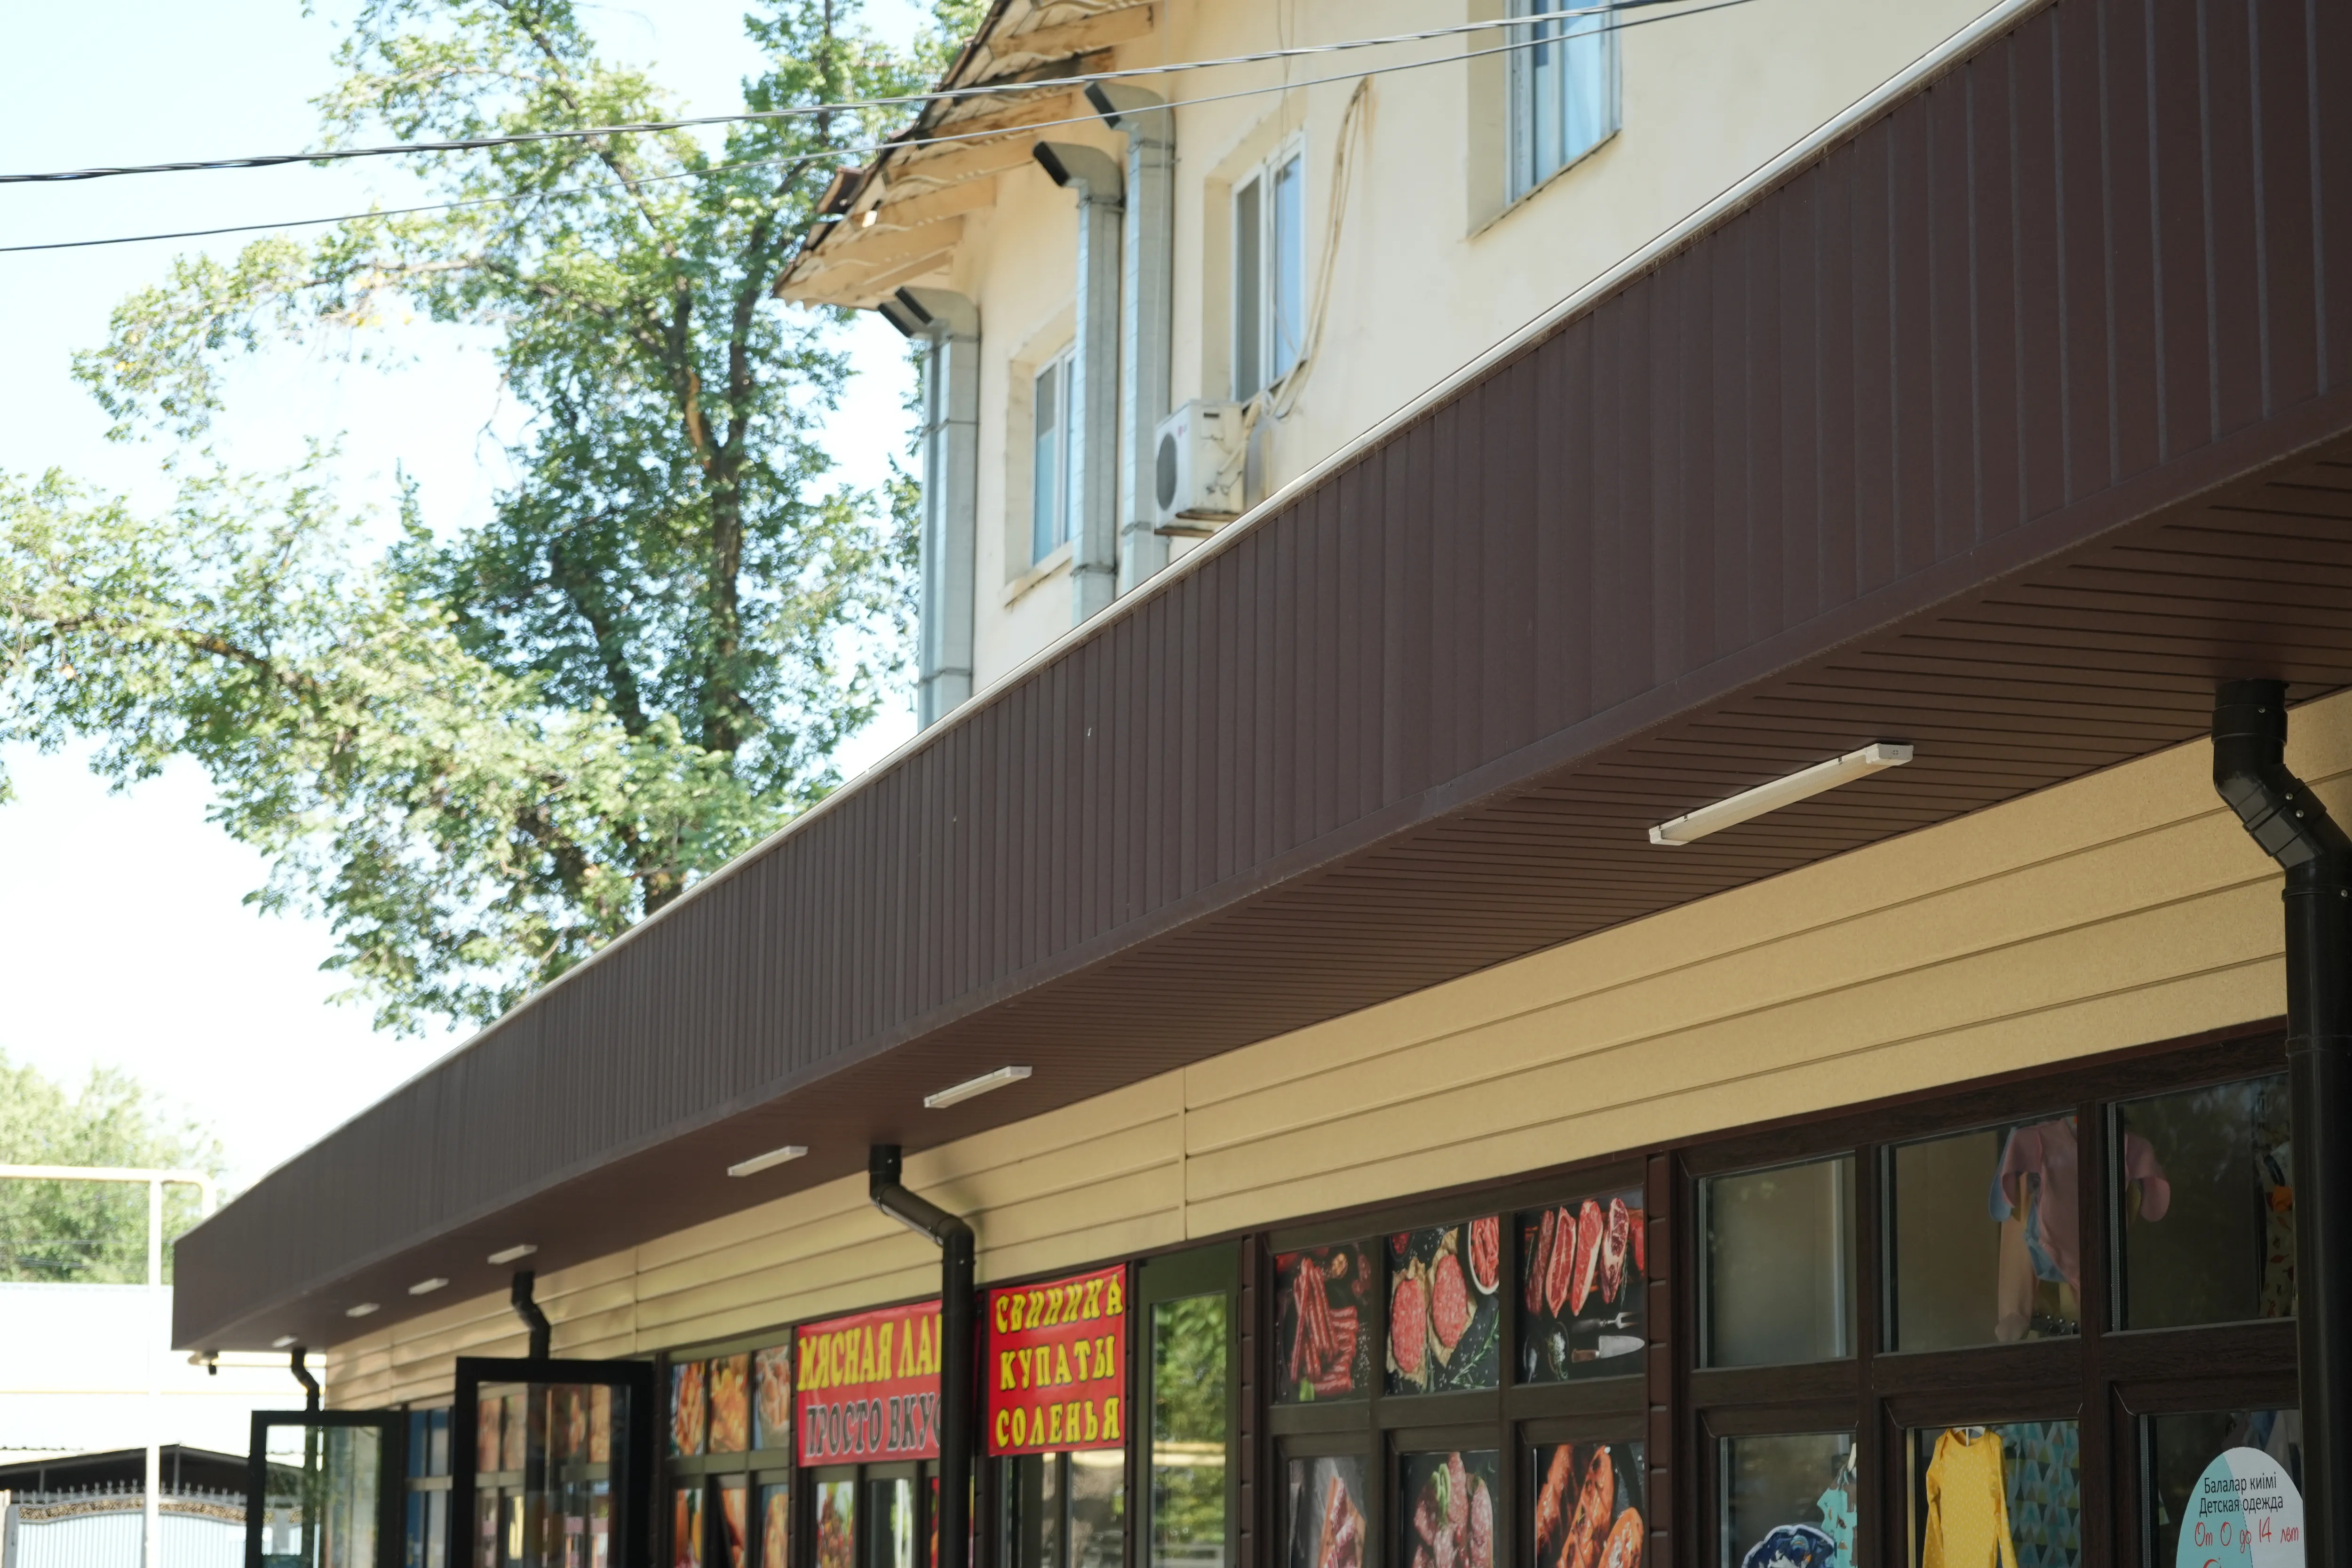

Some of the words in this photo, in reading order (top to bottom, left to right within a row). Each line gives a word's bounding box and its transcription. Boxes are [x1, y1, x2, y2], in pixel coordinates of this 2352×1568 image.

[996, 1273, 1124, 1334] СВИНИНА
[797, 1322, 894, 1391] МЯСНАЯ
[1000, 1335, 1116, 1391] КУПАТЫ
[806, 1398, 883, 1457] ПРОСТО
[996, 1396, 1120, 1449] СОЛЕНЬЯ
[2200, 1498, 2240, 1518] Детская
[2243, 1496, 2283, 1514] одежда
[2204, 1477, 2247, 1495] Балалар
[2250, 1472, 2277, 1490] киімі
[2195, 1522, 2213, 1547] От
[2220, 1521, 2232, 1546] 0
[2240, 1529, 2252, 1553] до
[2259, 1516, 2272, 1543] 14
[2280, 1527, 2299, 1544] лет
